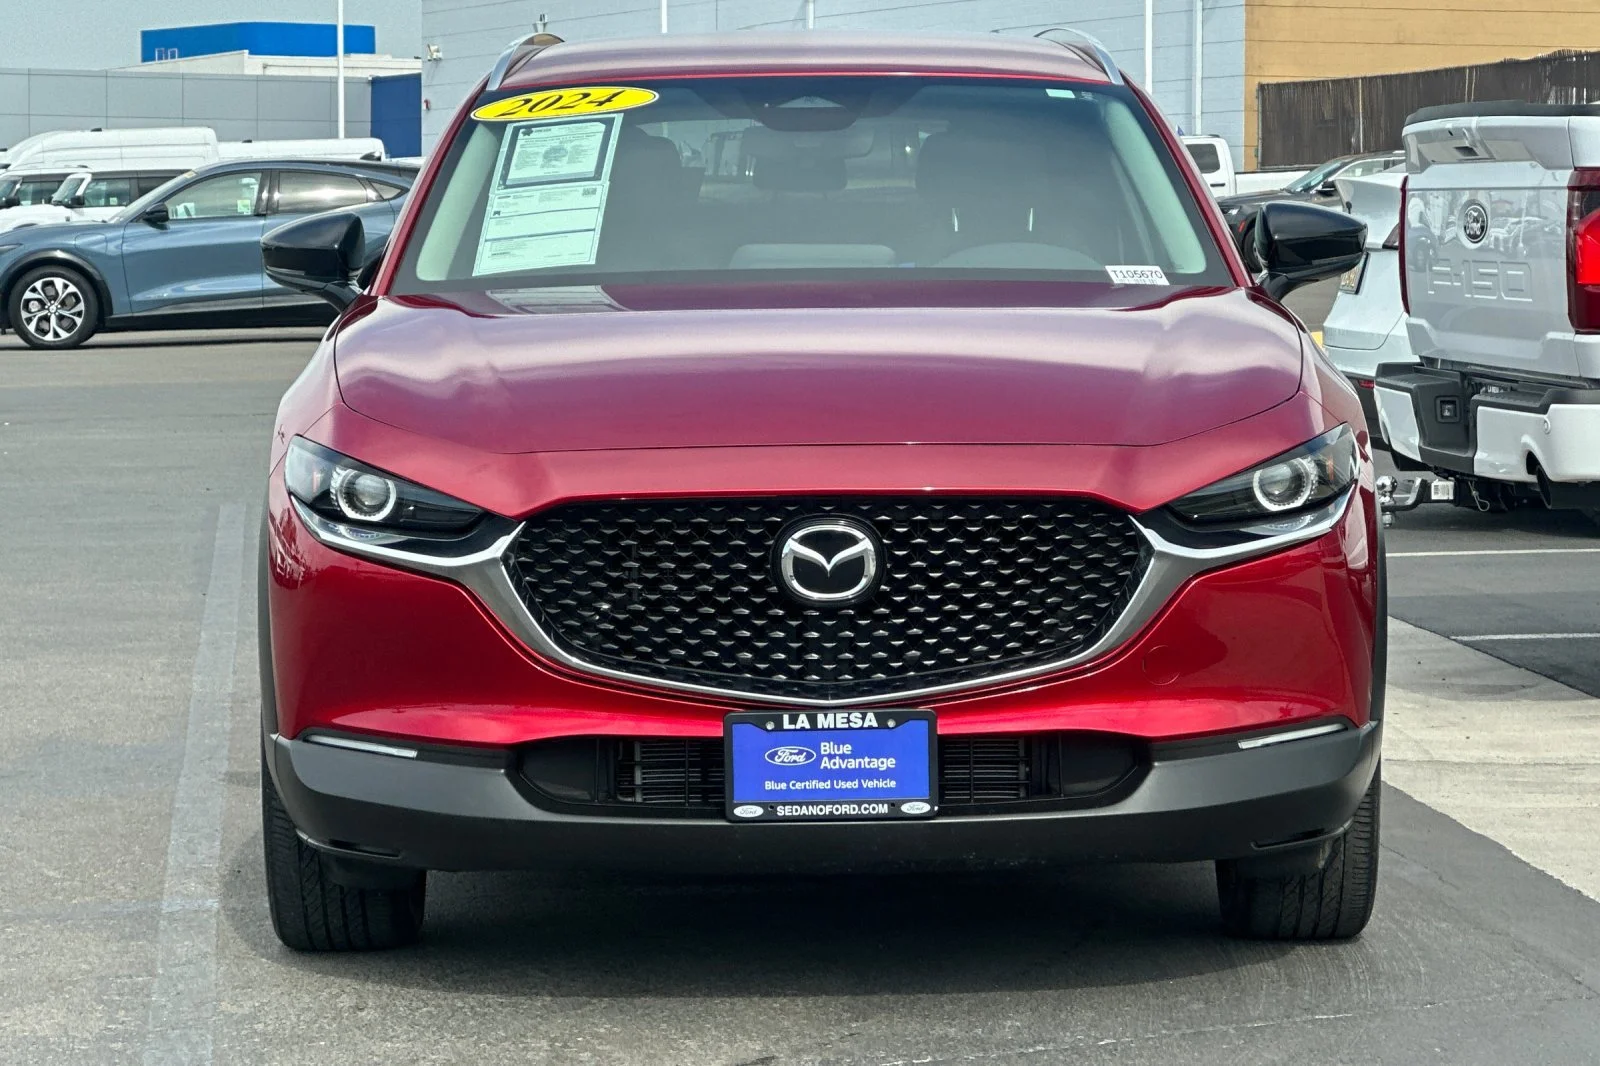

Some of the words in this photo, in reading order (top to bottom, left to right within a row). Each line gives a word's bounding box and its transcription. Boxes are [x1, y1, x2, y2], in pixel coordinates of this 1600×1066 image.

[494, 89, 626, 118] 2024
[1111, 270, 1163, 279] T105670
[1428, 258, 1532, 302] F-150
[783, 714, 810, 730] LA
[817, 712, 878, 729] MESA
[774, 748, 807, 764] Ford
[820, 742, 852, 755] Blue
[820, 756, 896, 771] Advantage
[765, 780, 787, 790] Blue
[789, 779, 830, 790] Certified
[834, 779, 858, 789] Used
[861, 778, 896, 789] Vehicle
[776, 803, 888, 816] SEDANOFORD.COM
